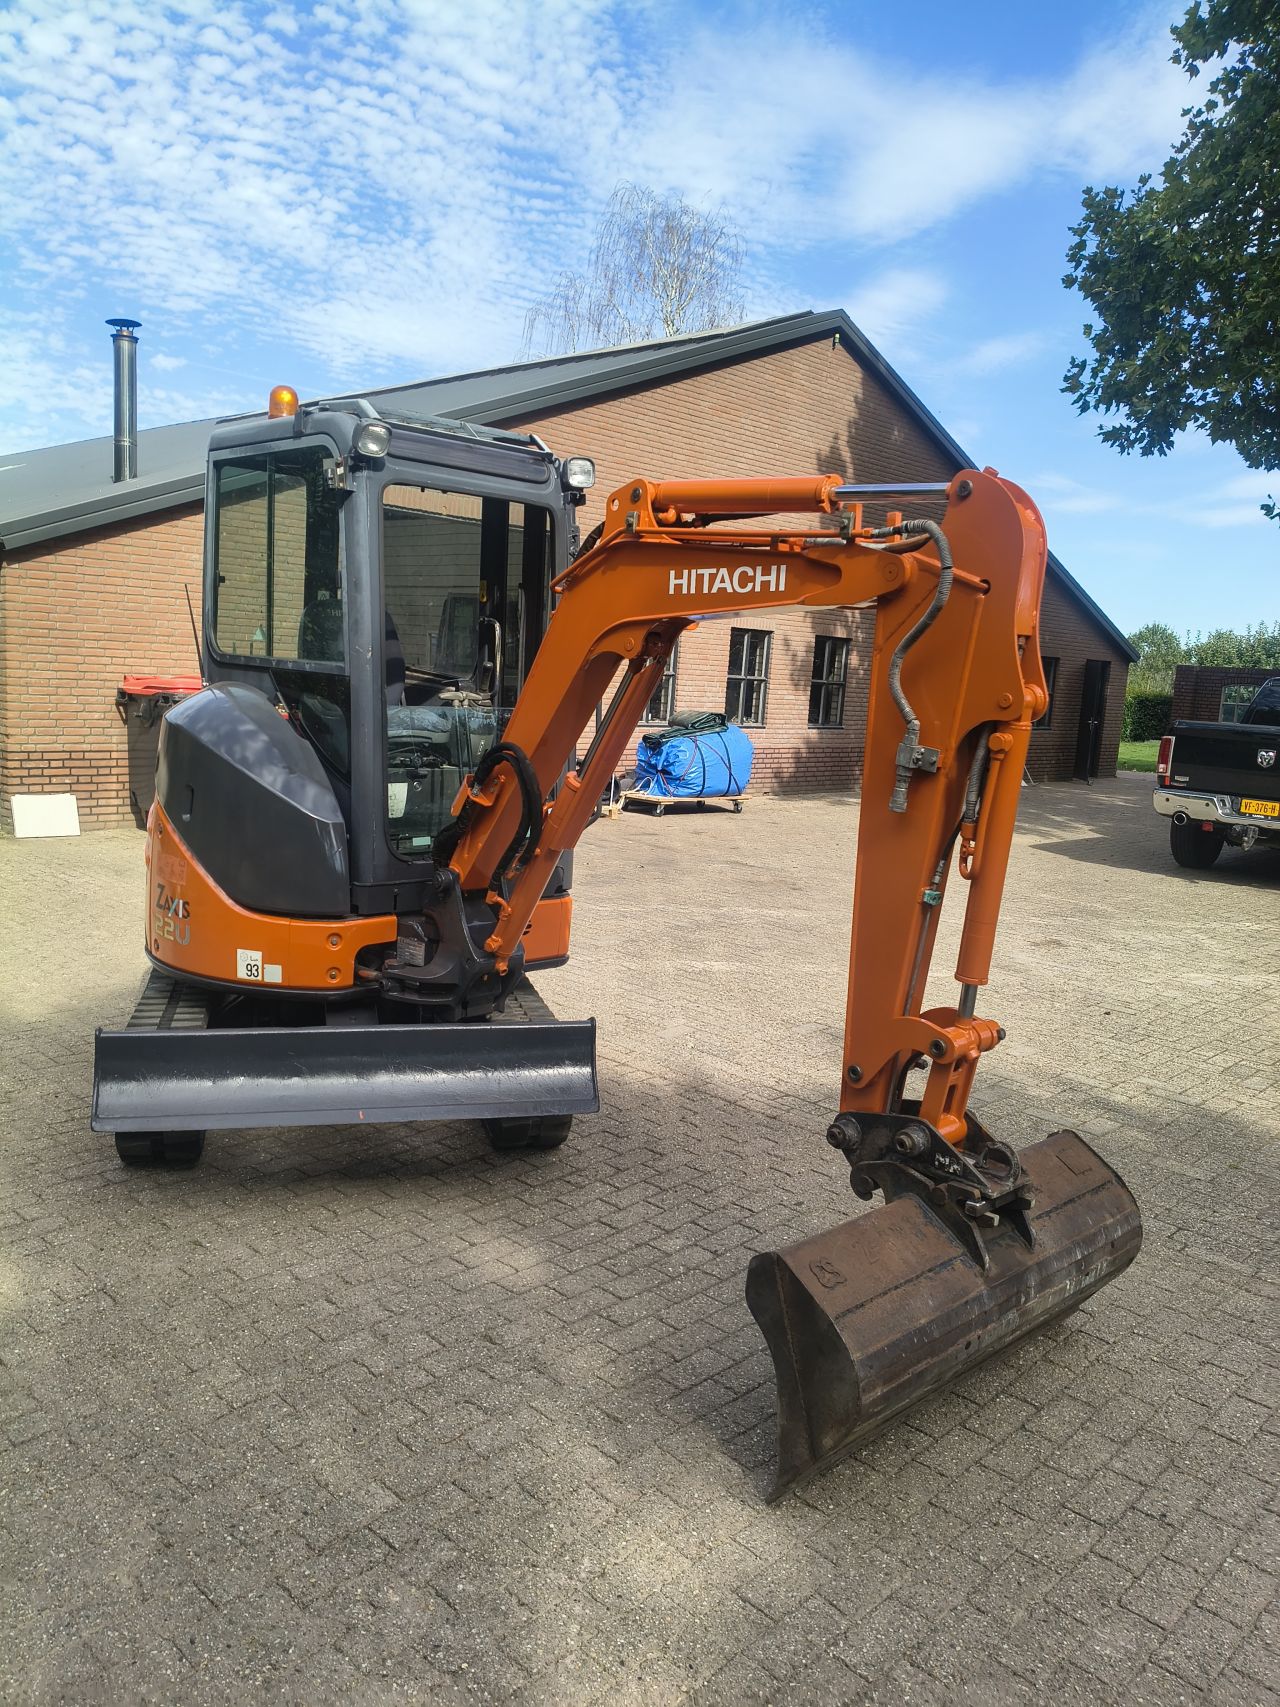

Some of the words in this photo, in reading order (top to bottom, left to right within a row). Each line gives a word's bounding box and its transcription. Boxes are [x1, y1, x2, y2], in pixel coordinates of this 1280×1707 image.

[668, 565, 787, 595] HITACHI
[156, 883, 190, 920] ZAXIS
[245, 963, 260, 978] 93
